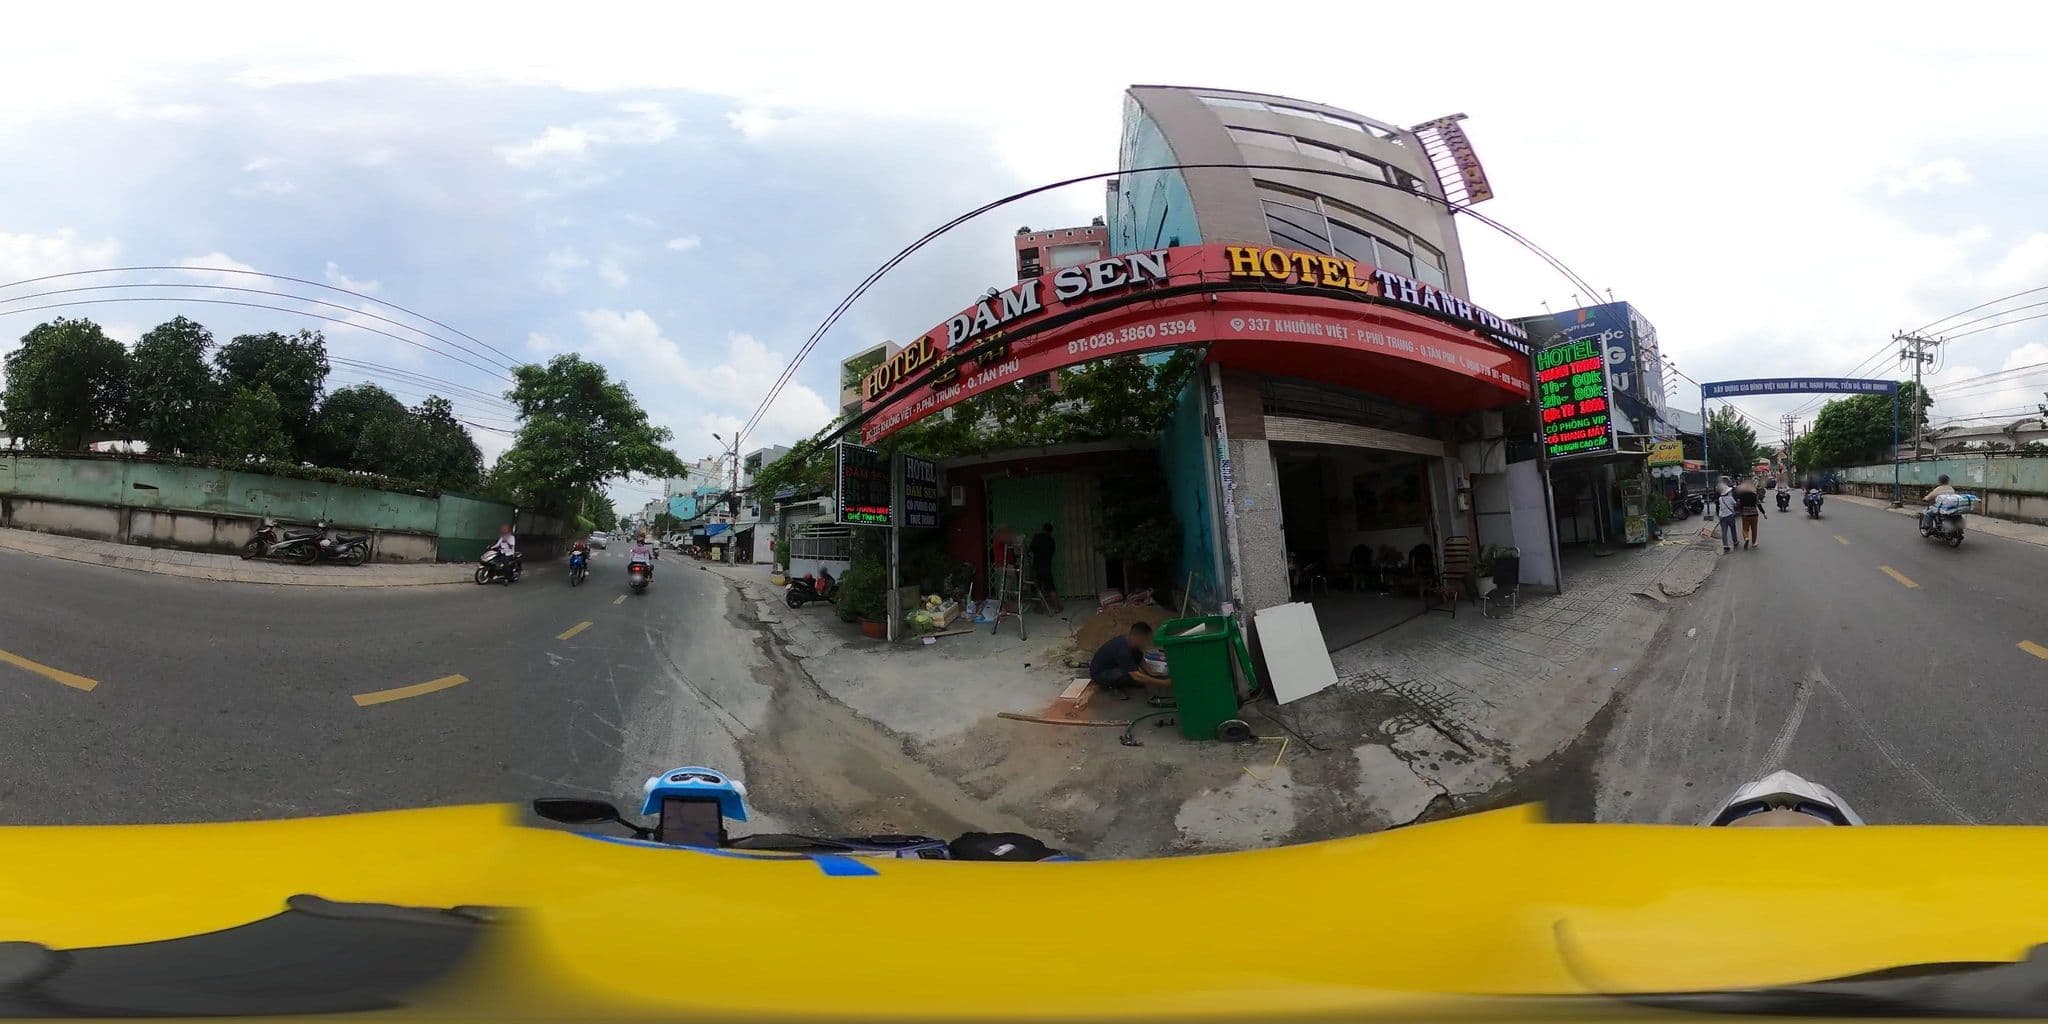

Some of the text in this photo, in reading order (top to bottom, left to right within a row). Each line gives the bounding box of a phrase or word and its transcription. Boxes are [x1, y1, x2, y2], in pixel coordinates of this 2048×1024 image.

[1227, 246, 1369, 293] HOTEL
[1376, 269, 1473, 321] THANH
[868, 336, 934, 399] HOTEL
[1054, 250, 1168, 300] SEN
[1160, 319, 1197, 336] 5394
[1248, 318, 1270, 331] 337
[1325, 323, 1347, 341] VIỆT
[1386, 335, 1414, 352] TRUNG
[1537, 340, 1599, 370] HOTEL
[936, 383, 960, 404] TRUNG
[998, 356, 1019, 377] PHÚ
[1592, 415, 1607, 425] VIP
[1561, 430, 1586, 441] THANG
[1579, 440, 1593, 449] CAO
[906, 457, 936, 483] HOTEL
